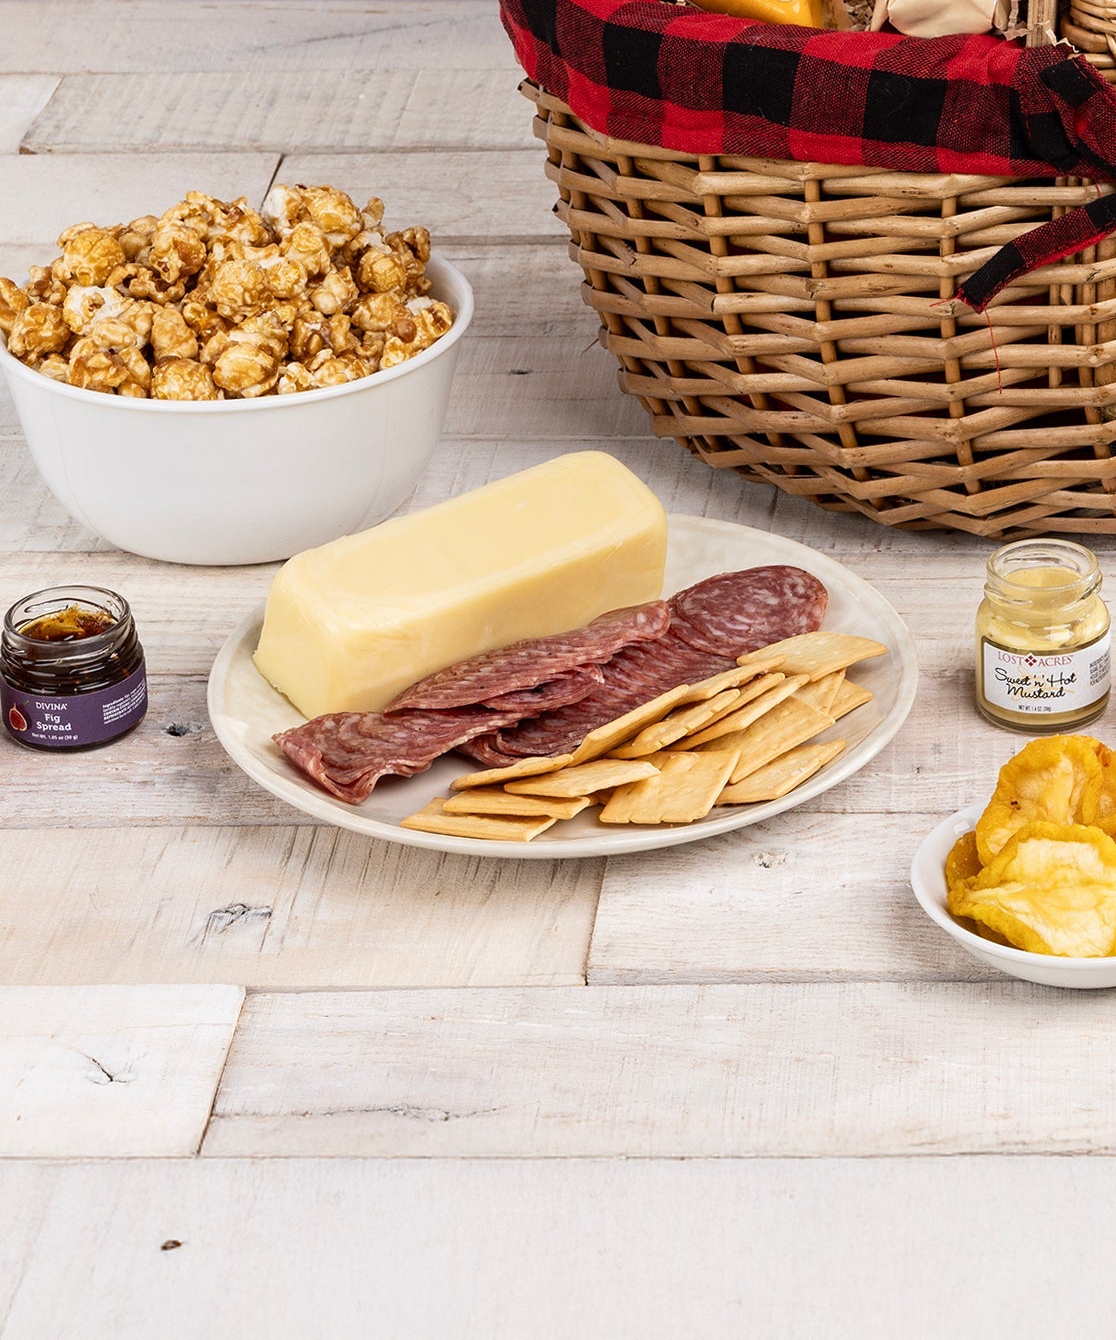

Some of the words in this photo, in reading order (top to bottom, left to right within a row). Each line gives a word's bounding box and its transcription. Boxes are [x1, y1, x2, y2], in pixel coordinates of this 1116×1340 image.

[998, 651, 1023, 666] LOST
[1037, 654, 1074, 667] ACRES
[994, 667, 1031, 686] Sweet
[1046, 671, 1077, 687] Hot
[1006, 683, 1066, 699] Mustard
[35, 701, 68, 711] DIVINA
[44, 713, 61, 724] Fig
[36, 720, 72, 732] Spread
